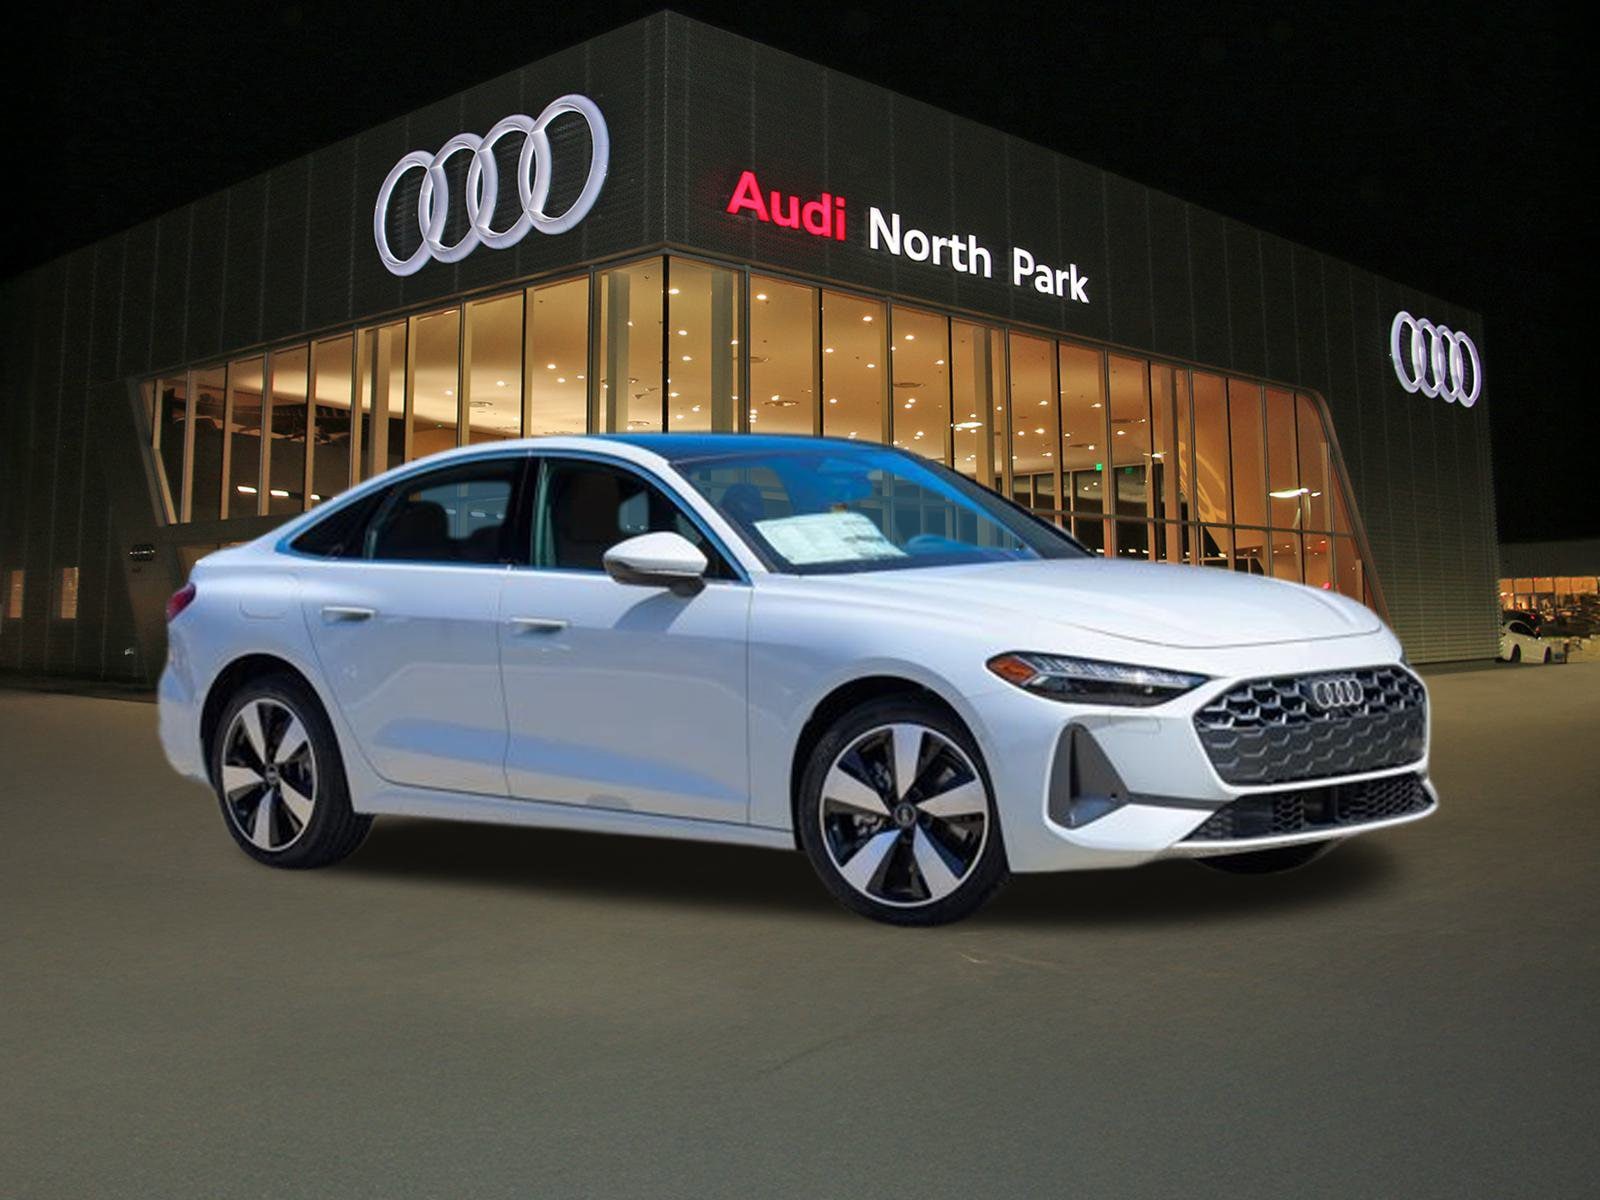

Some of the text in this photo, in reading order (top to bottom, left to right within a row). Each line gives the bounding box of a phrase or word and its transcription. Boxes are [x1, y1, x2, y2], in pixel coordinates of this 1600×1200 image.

[726, 171, 1090, 304] Audi North Park
